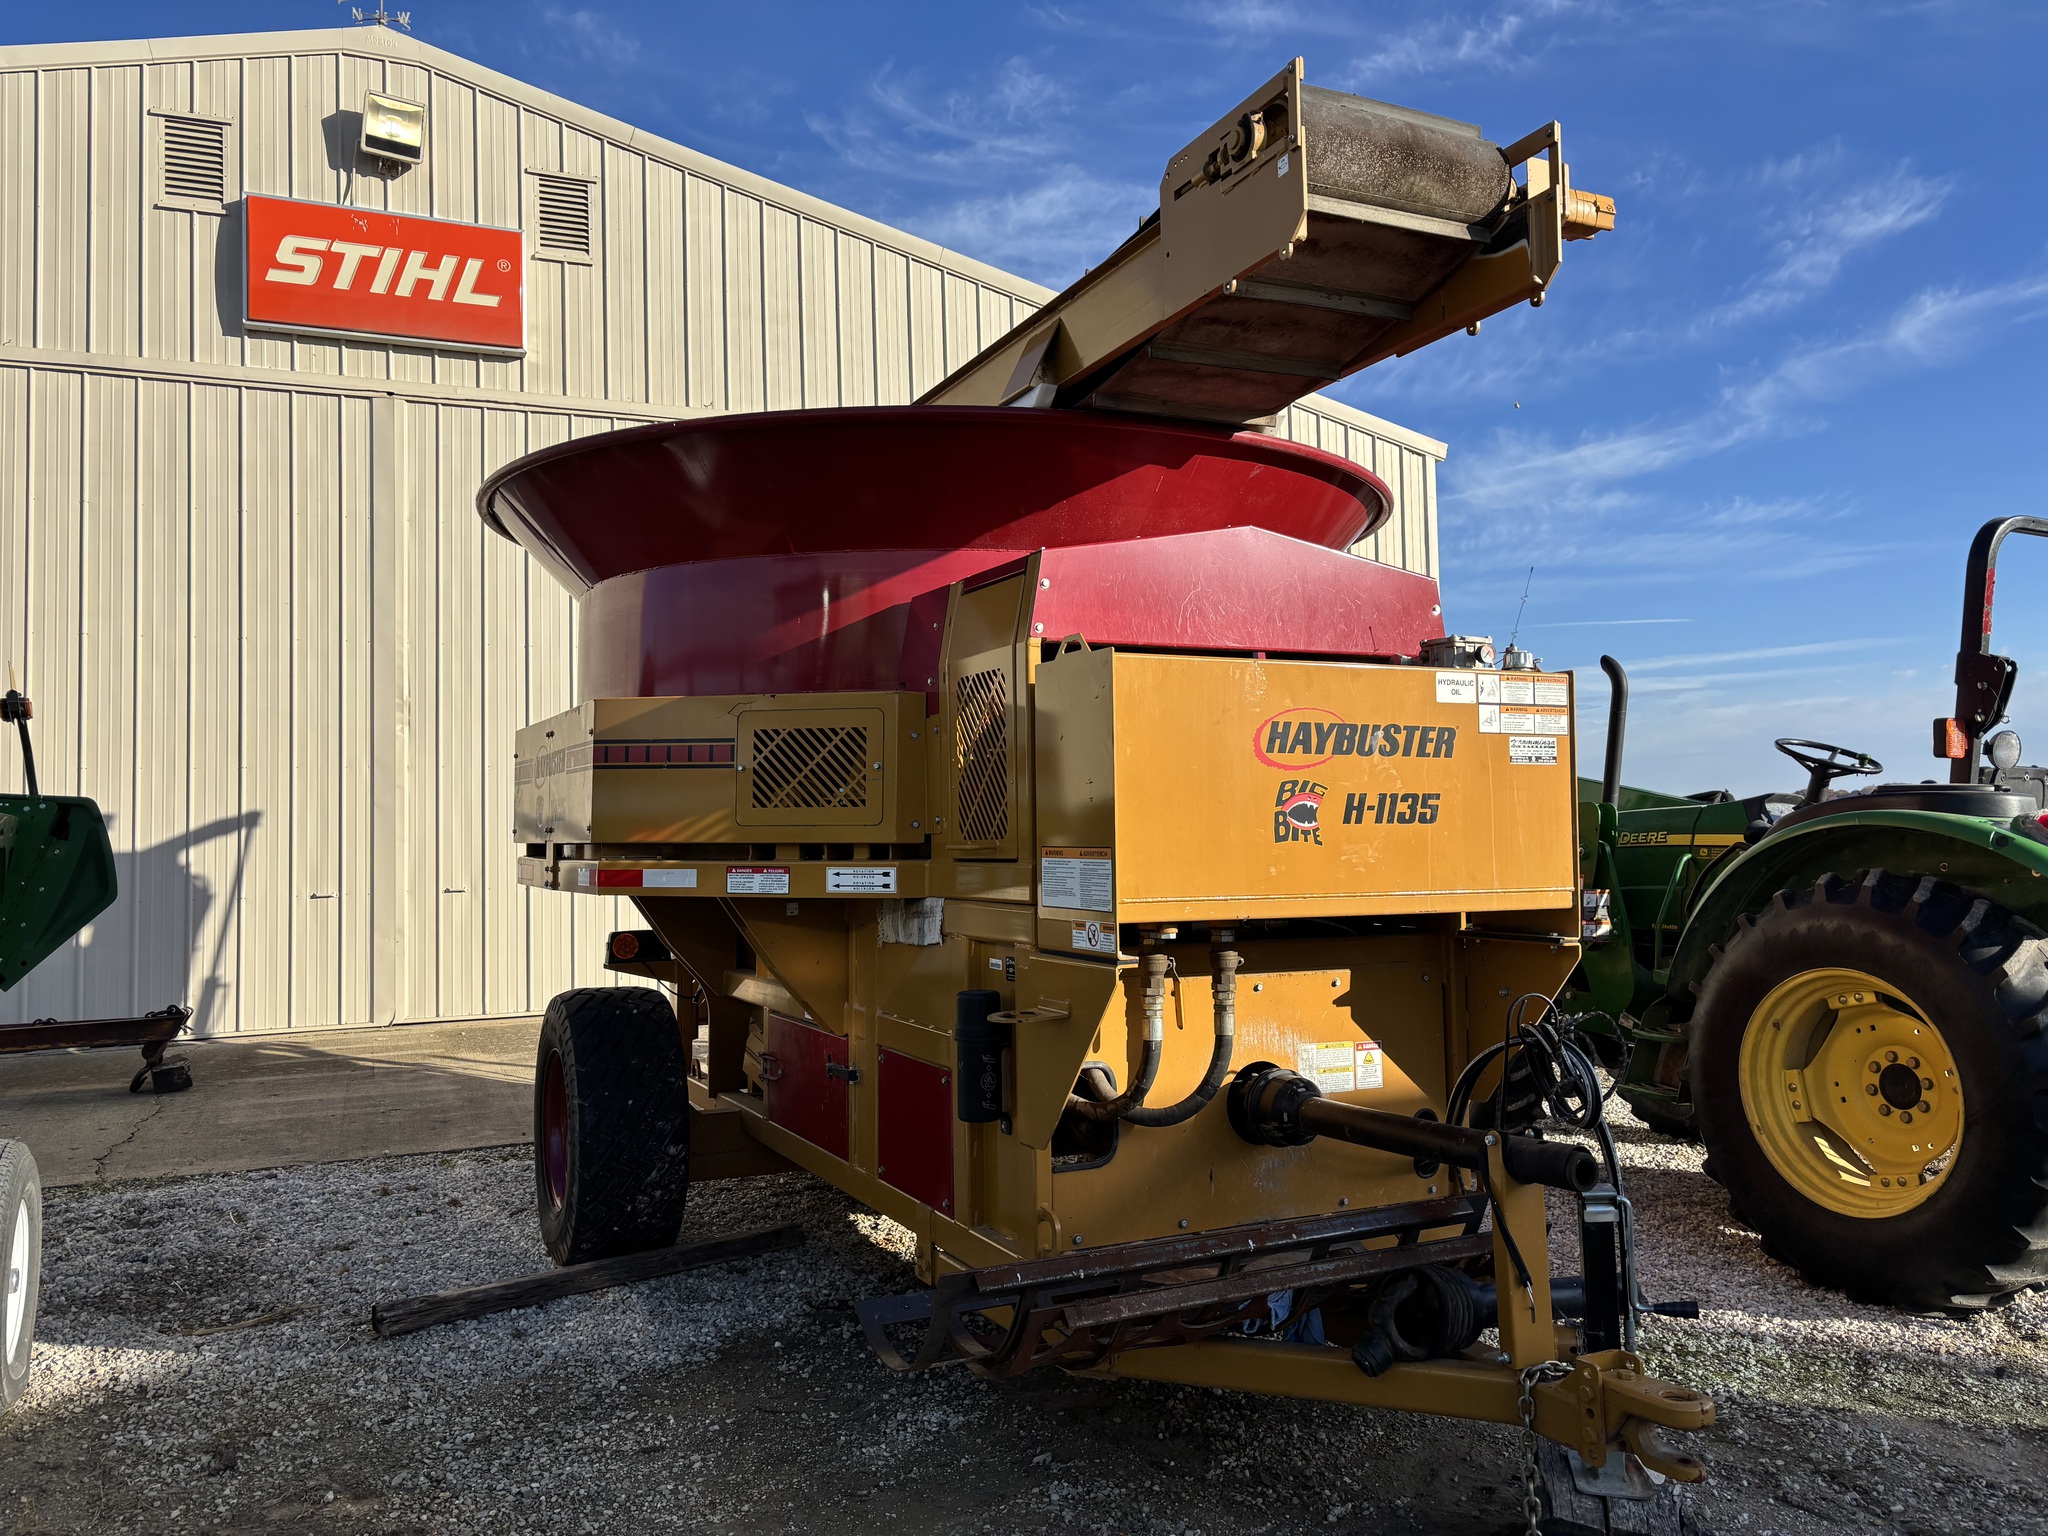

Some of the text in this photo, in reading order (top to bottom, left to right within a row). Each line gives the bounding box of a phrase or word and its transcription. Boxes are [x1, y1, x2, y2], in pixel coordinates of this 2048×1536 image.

[365, 34, 398, 48] MORTON
[265, 234, 503, 307] STIHL
[1437, 678, 1475, 687] HYDRAULIC
[1450, 688, 1462, 696] OIL
[1265, 720, 1457, 759] HAYBUSTER
[1275, 779, 1329, 808] BIG
[1342, 792, 1441, 825] H-1135
[1274, 810, 1324, 846] BITE
[1619, 831, 1668, 845] DEERE
